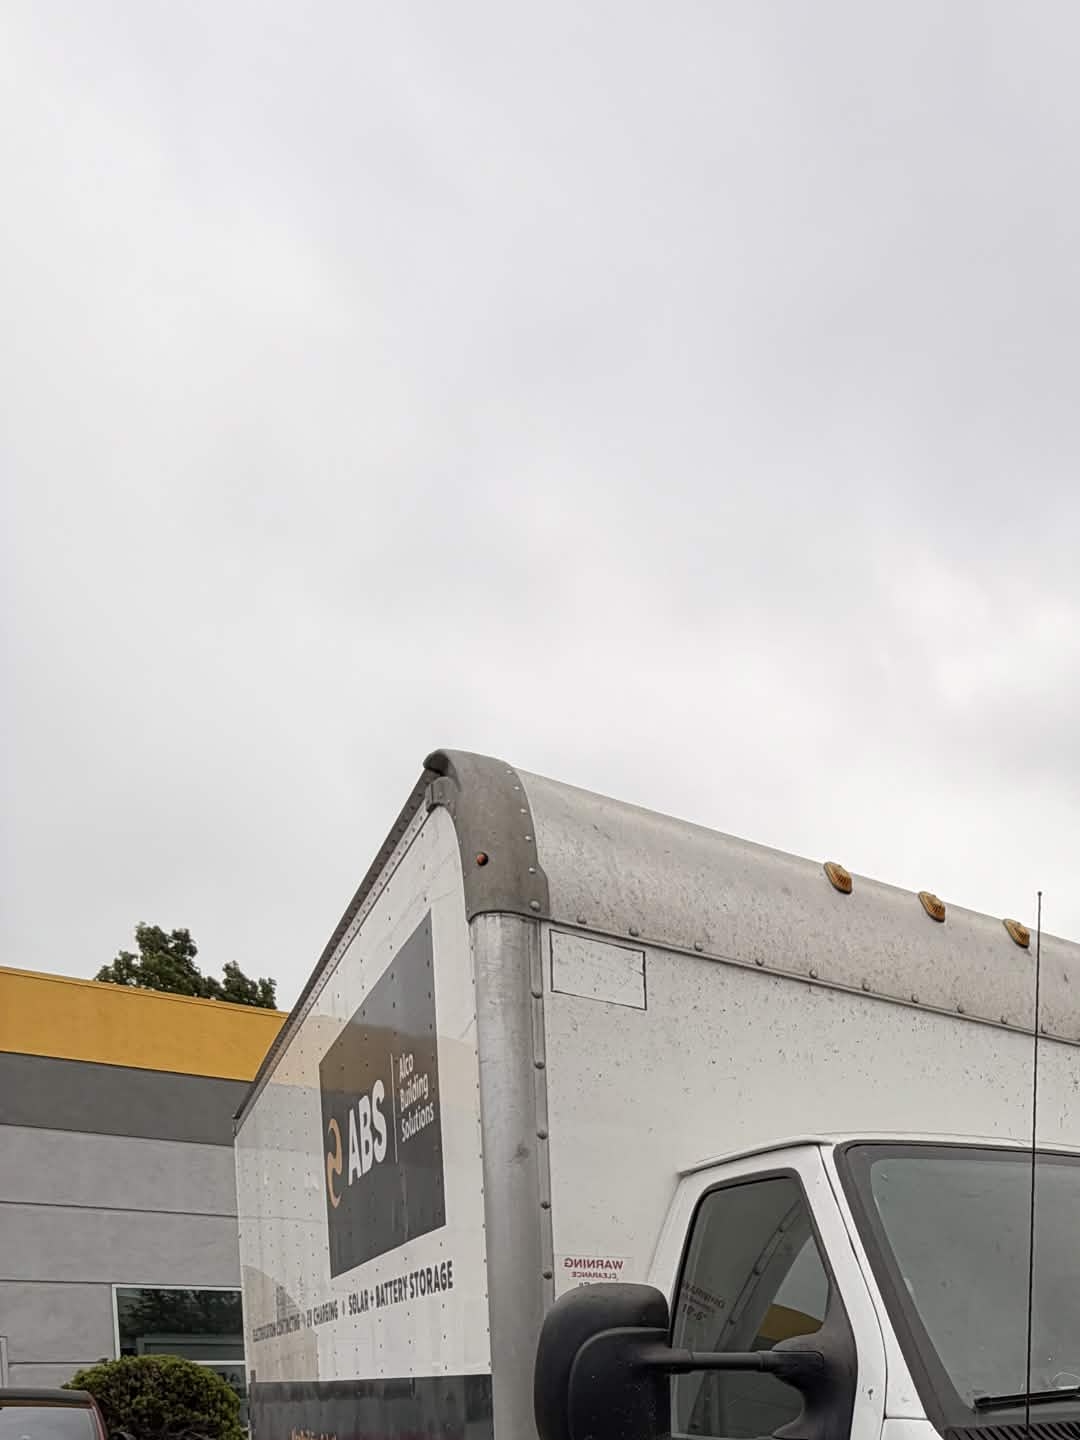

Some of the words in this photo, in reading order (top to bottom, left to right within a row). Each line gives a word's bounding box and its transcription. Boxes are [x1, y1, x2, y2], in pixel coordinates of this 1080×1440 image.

[399, 1053, 414, 1083] Alco
[400, 1073, 429, 1113] Building
[348, 1079, 387, 1187] ABS
[401, 1102, 434, 1143] Solutions
[348, 1289, 369, 1316] SOLAR
[375, 1276, 408, 1308] BATTERY
[409, 1261, 454, 1299] STORAGE
